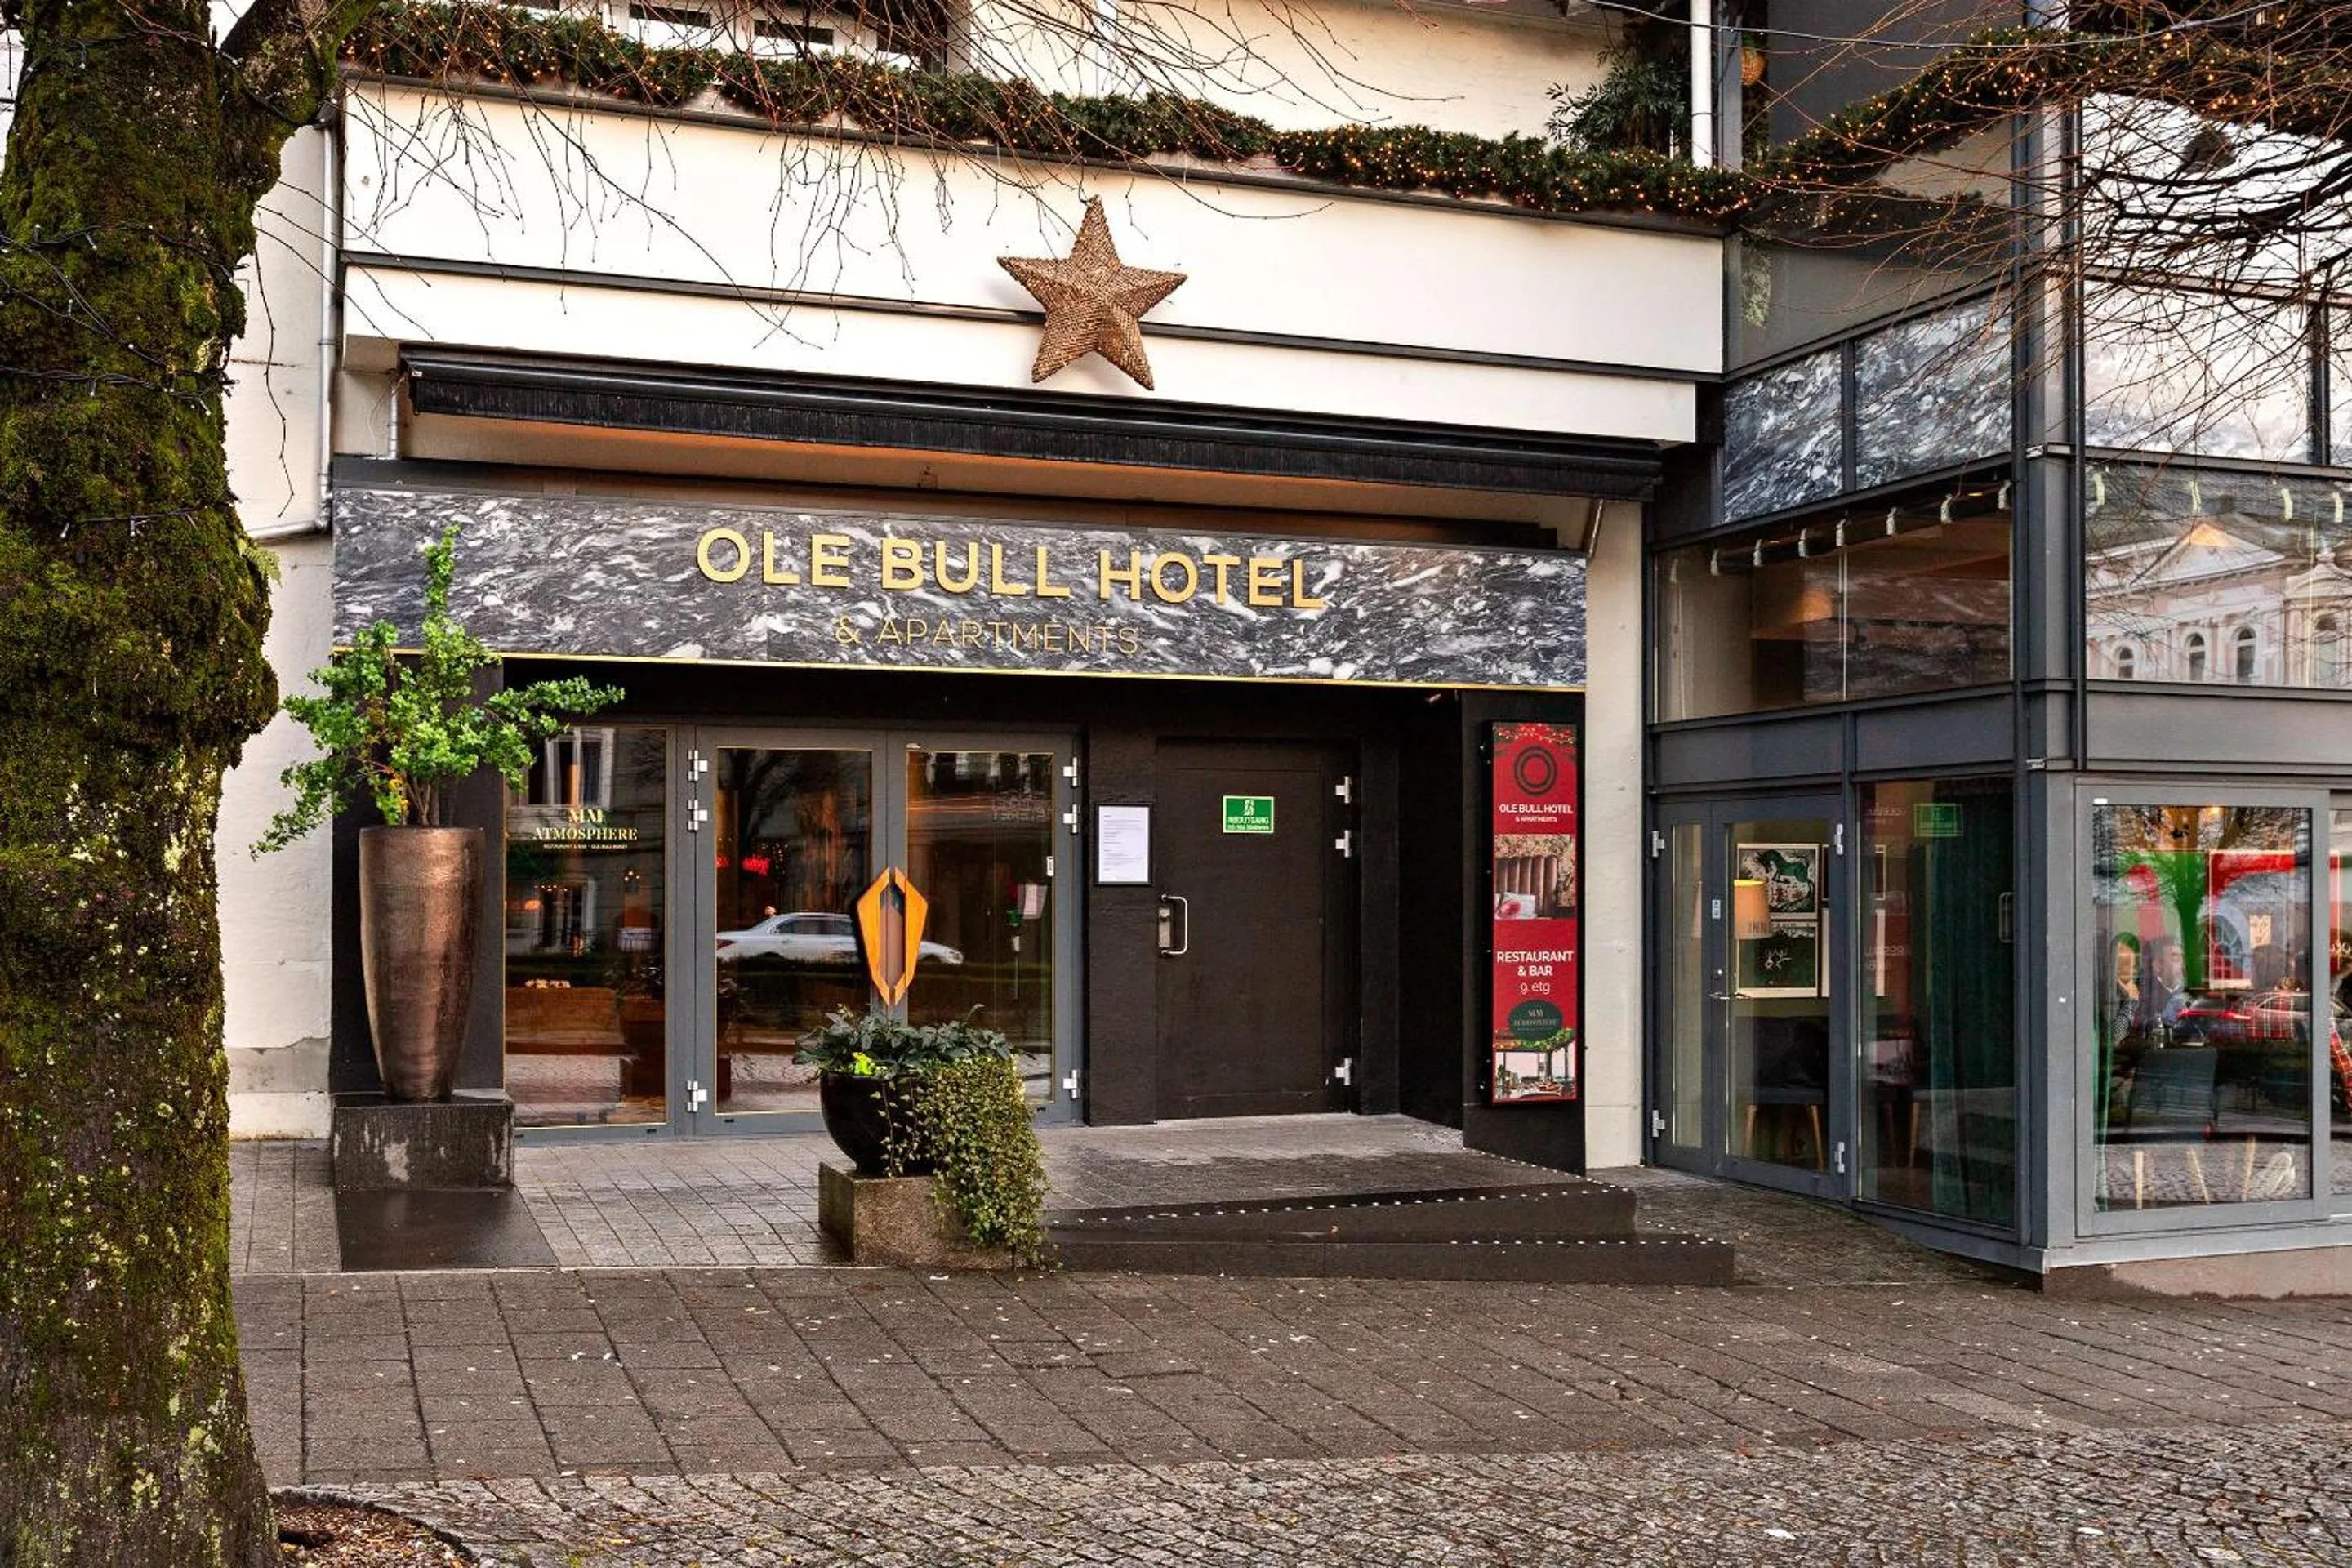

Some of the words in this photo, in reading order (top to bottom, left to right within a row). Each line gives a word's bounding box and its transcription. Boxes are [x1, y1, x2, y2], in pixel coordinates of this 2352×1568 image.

[697, 528, 851, 589] OLE
[881, 537, 1070, 598] BULL
[1099, 549, 1326, 609] HOTEL
[834, 615, 860, 645] &
[876, 618, 1139, 654] APARTMENTS
[1499, 803, 1518, 813] OLE
[1519, 803, 1543, 813] BULL
[1544, 804, 1575, 814] HOTEL
[532, 827, 639, 840] ATMOSPHERE
[1496, 951, 1575, 963] RESTAURANT
[1517, 965, 1526, 977] &
[1529, 965, 1553, 977] BAR
